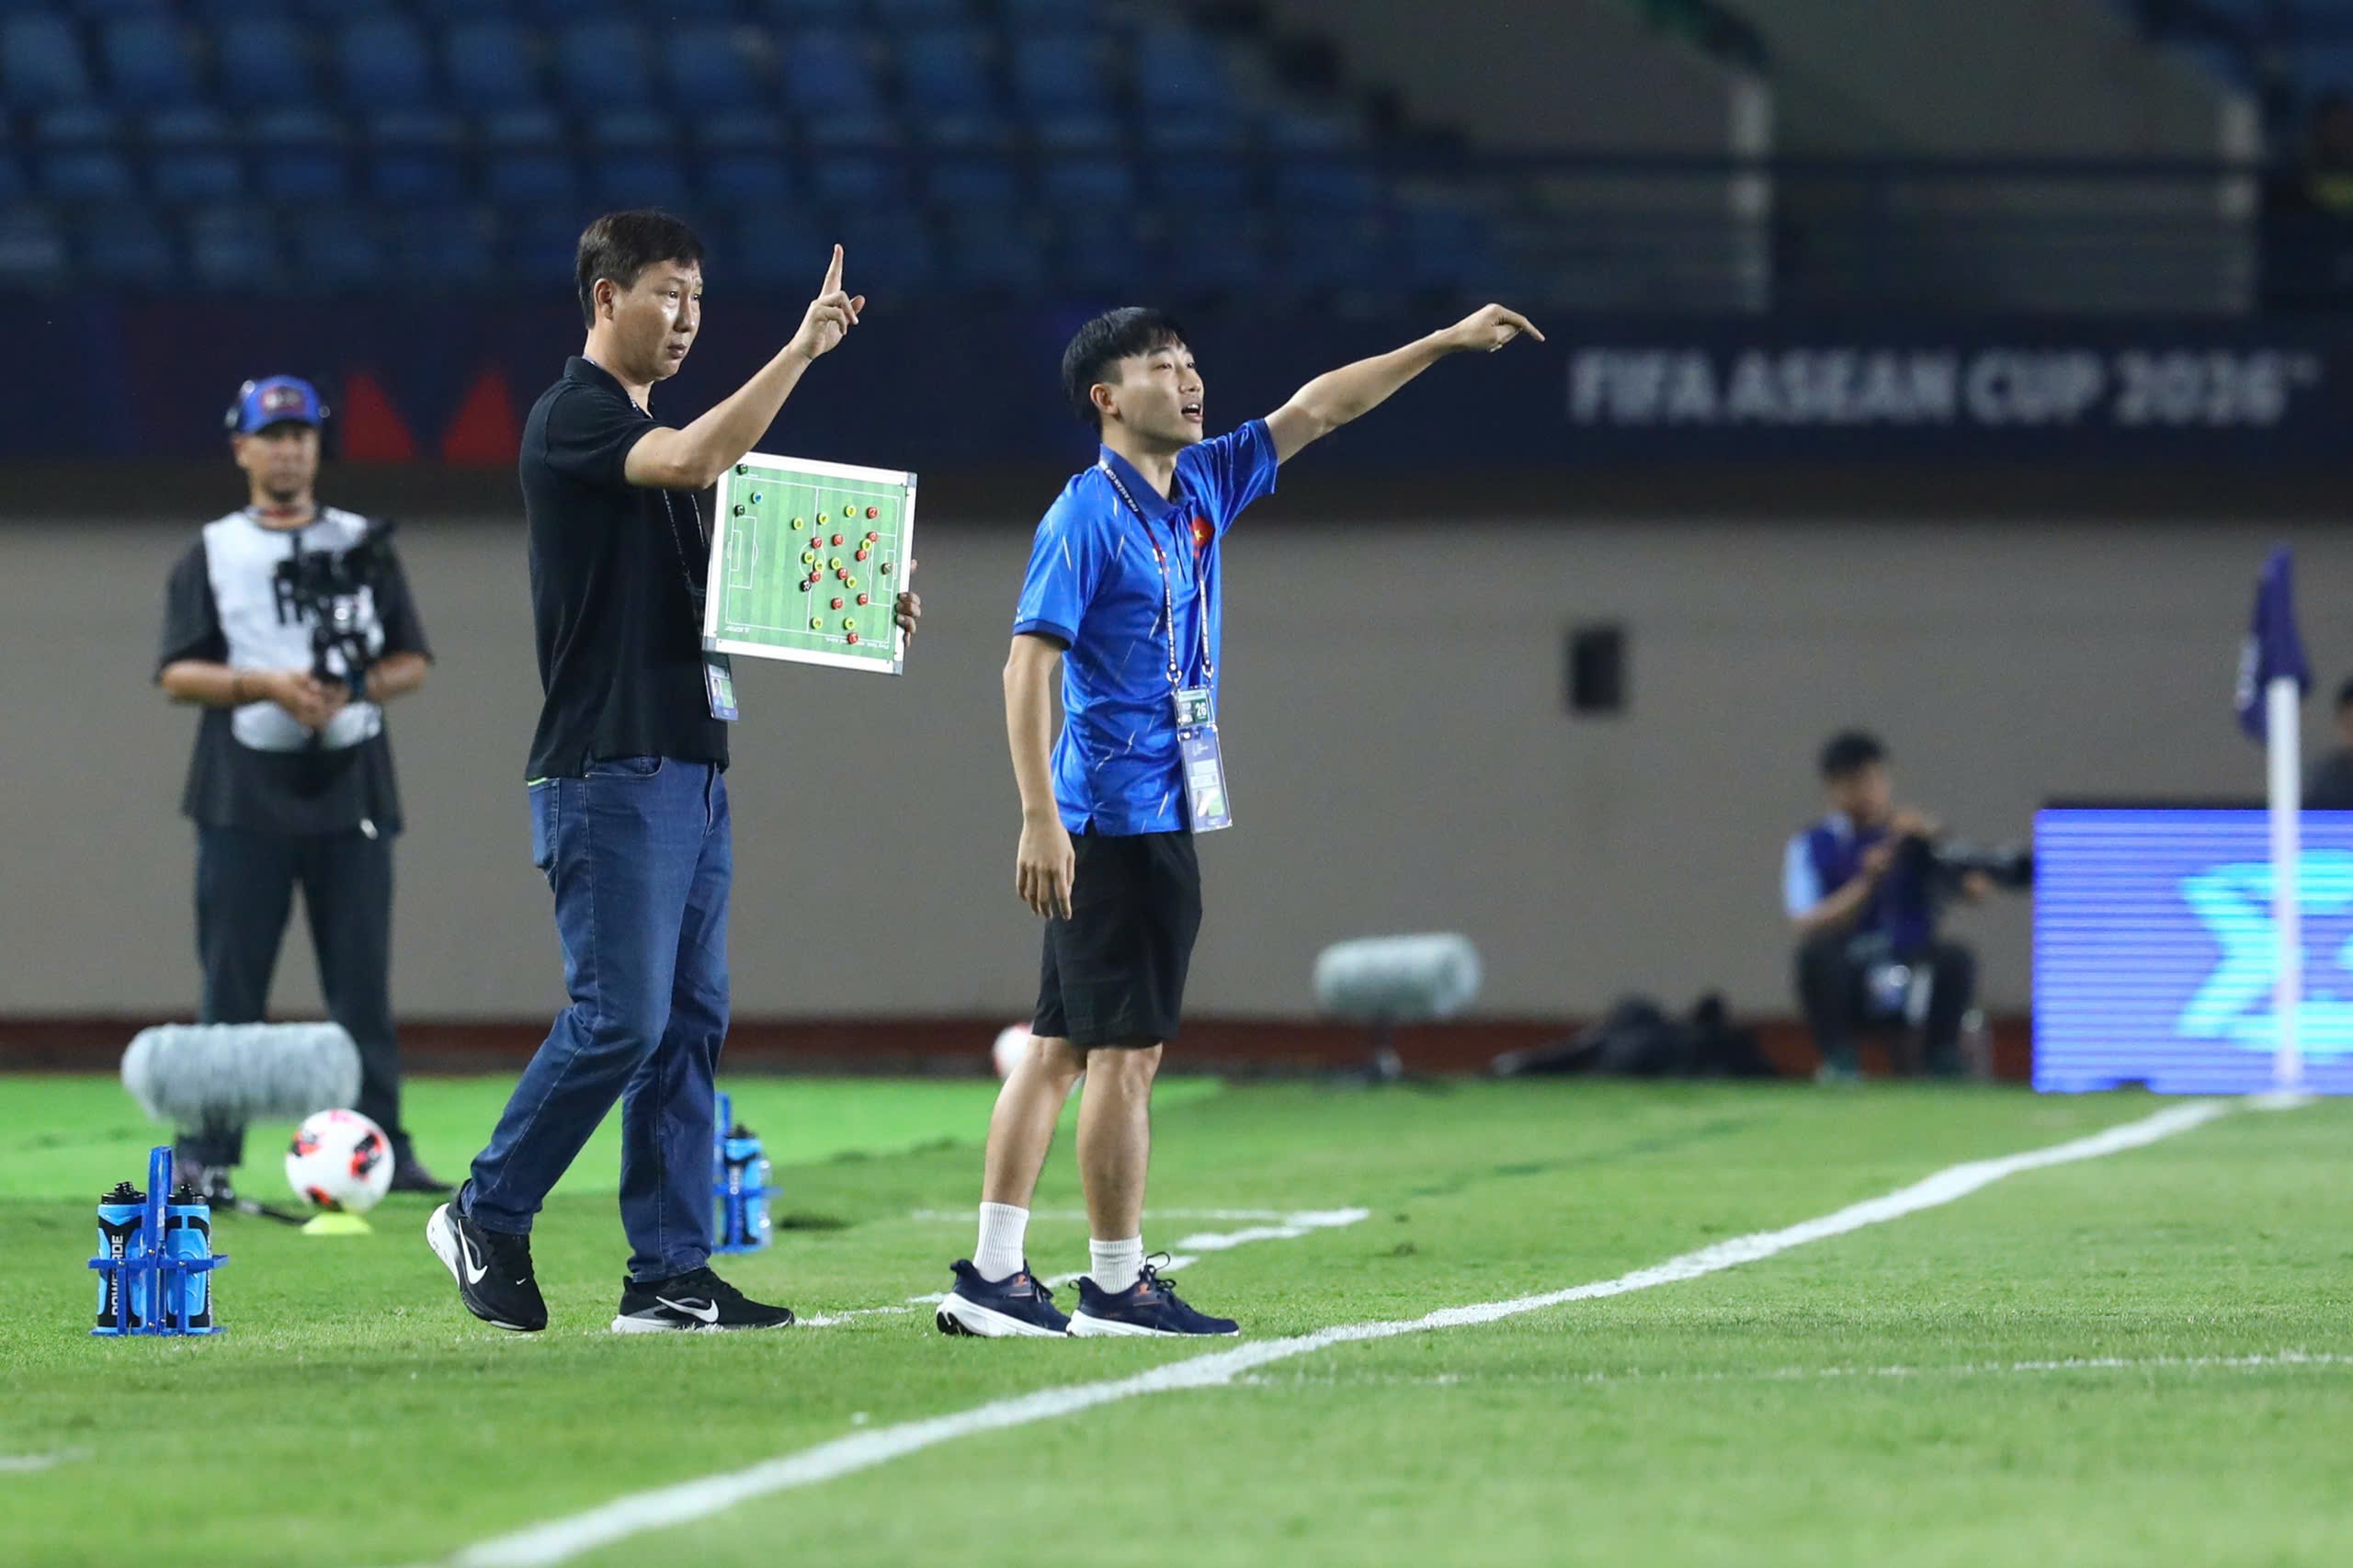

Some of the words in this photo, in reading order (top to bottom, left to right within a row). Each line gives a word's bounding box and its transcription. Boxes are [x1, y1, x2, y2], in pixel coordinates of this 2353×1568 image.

[1571, 351, 1715, 423] FIFA
[1726, 351, 1956, 423] ASEAN
[1965, 351, 2105, 423] CUP
